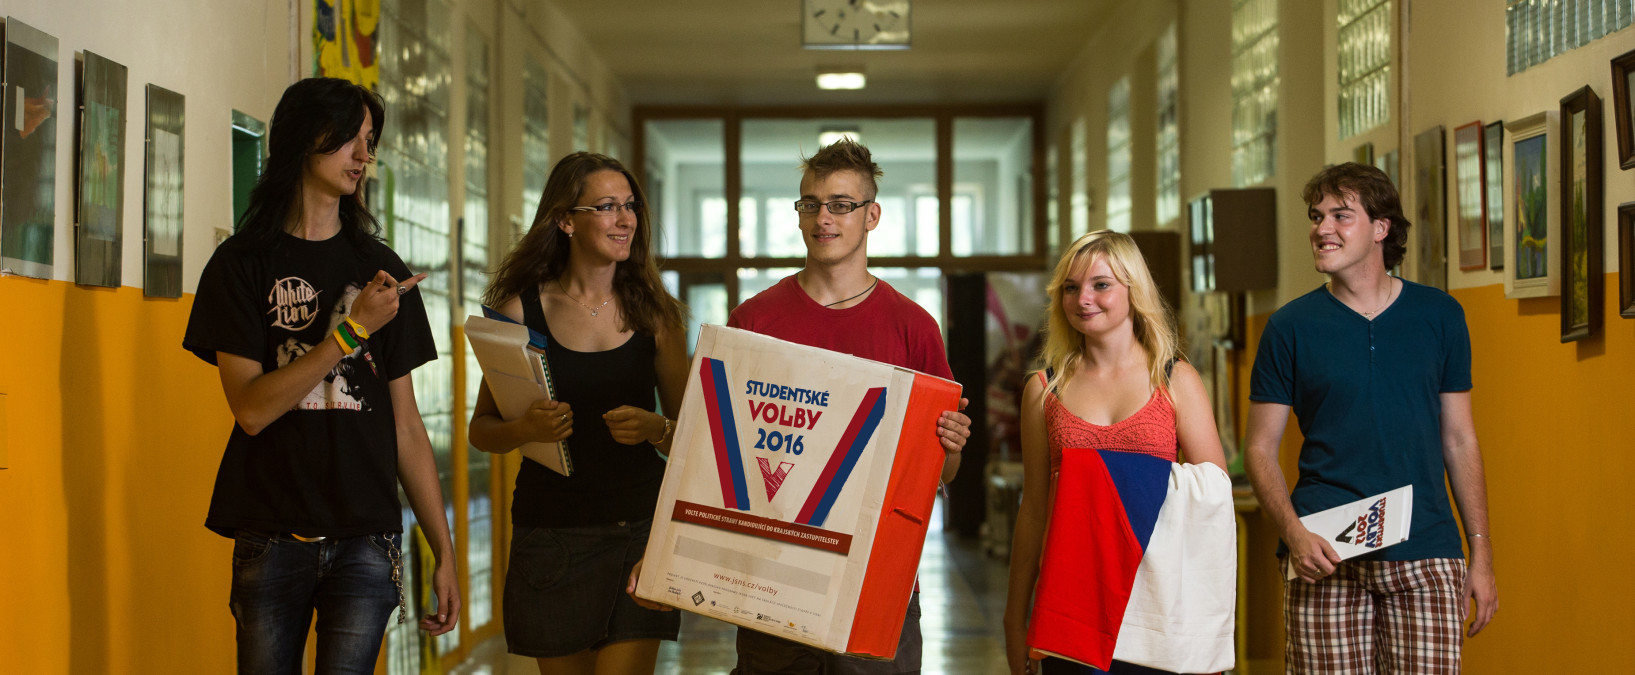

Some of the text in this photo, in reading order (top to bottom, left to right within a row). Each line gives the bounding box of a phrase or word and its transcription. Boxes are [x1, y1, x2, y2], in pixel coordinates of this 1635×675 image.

[274, 279, 321, 307] White
[268, 303, 320, 328] Lion
[306, 402, 318, 410] TO
[746, 380, 829, 407] STUDENTSKÉ
[748, 399, 823, 430] VOLBY
[753, 427, 804, 455] 2016
[685, 508, 698, 517] VOLTE
[698, 511, 721, 522] POLITICKÉ
[721, 515, 739, 525] STRANY
[773, 526, 801, 538] KRAJSKÝCH
[800, 532, 840, 546] ZASTUPITELSTEV
[1355, 514, 1368, 545] 2012
[1365, 500, 1380, 548] VOLBY
[713, 573, 779, 597] www.jsns.cz/volby
